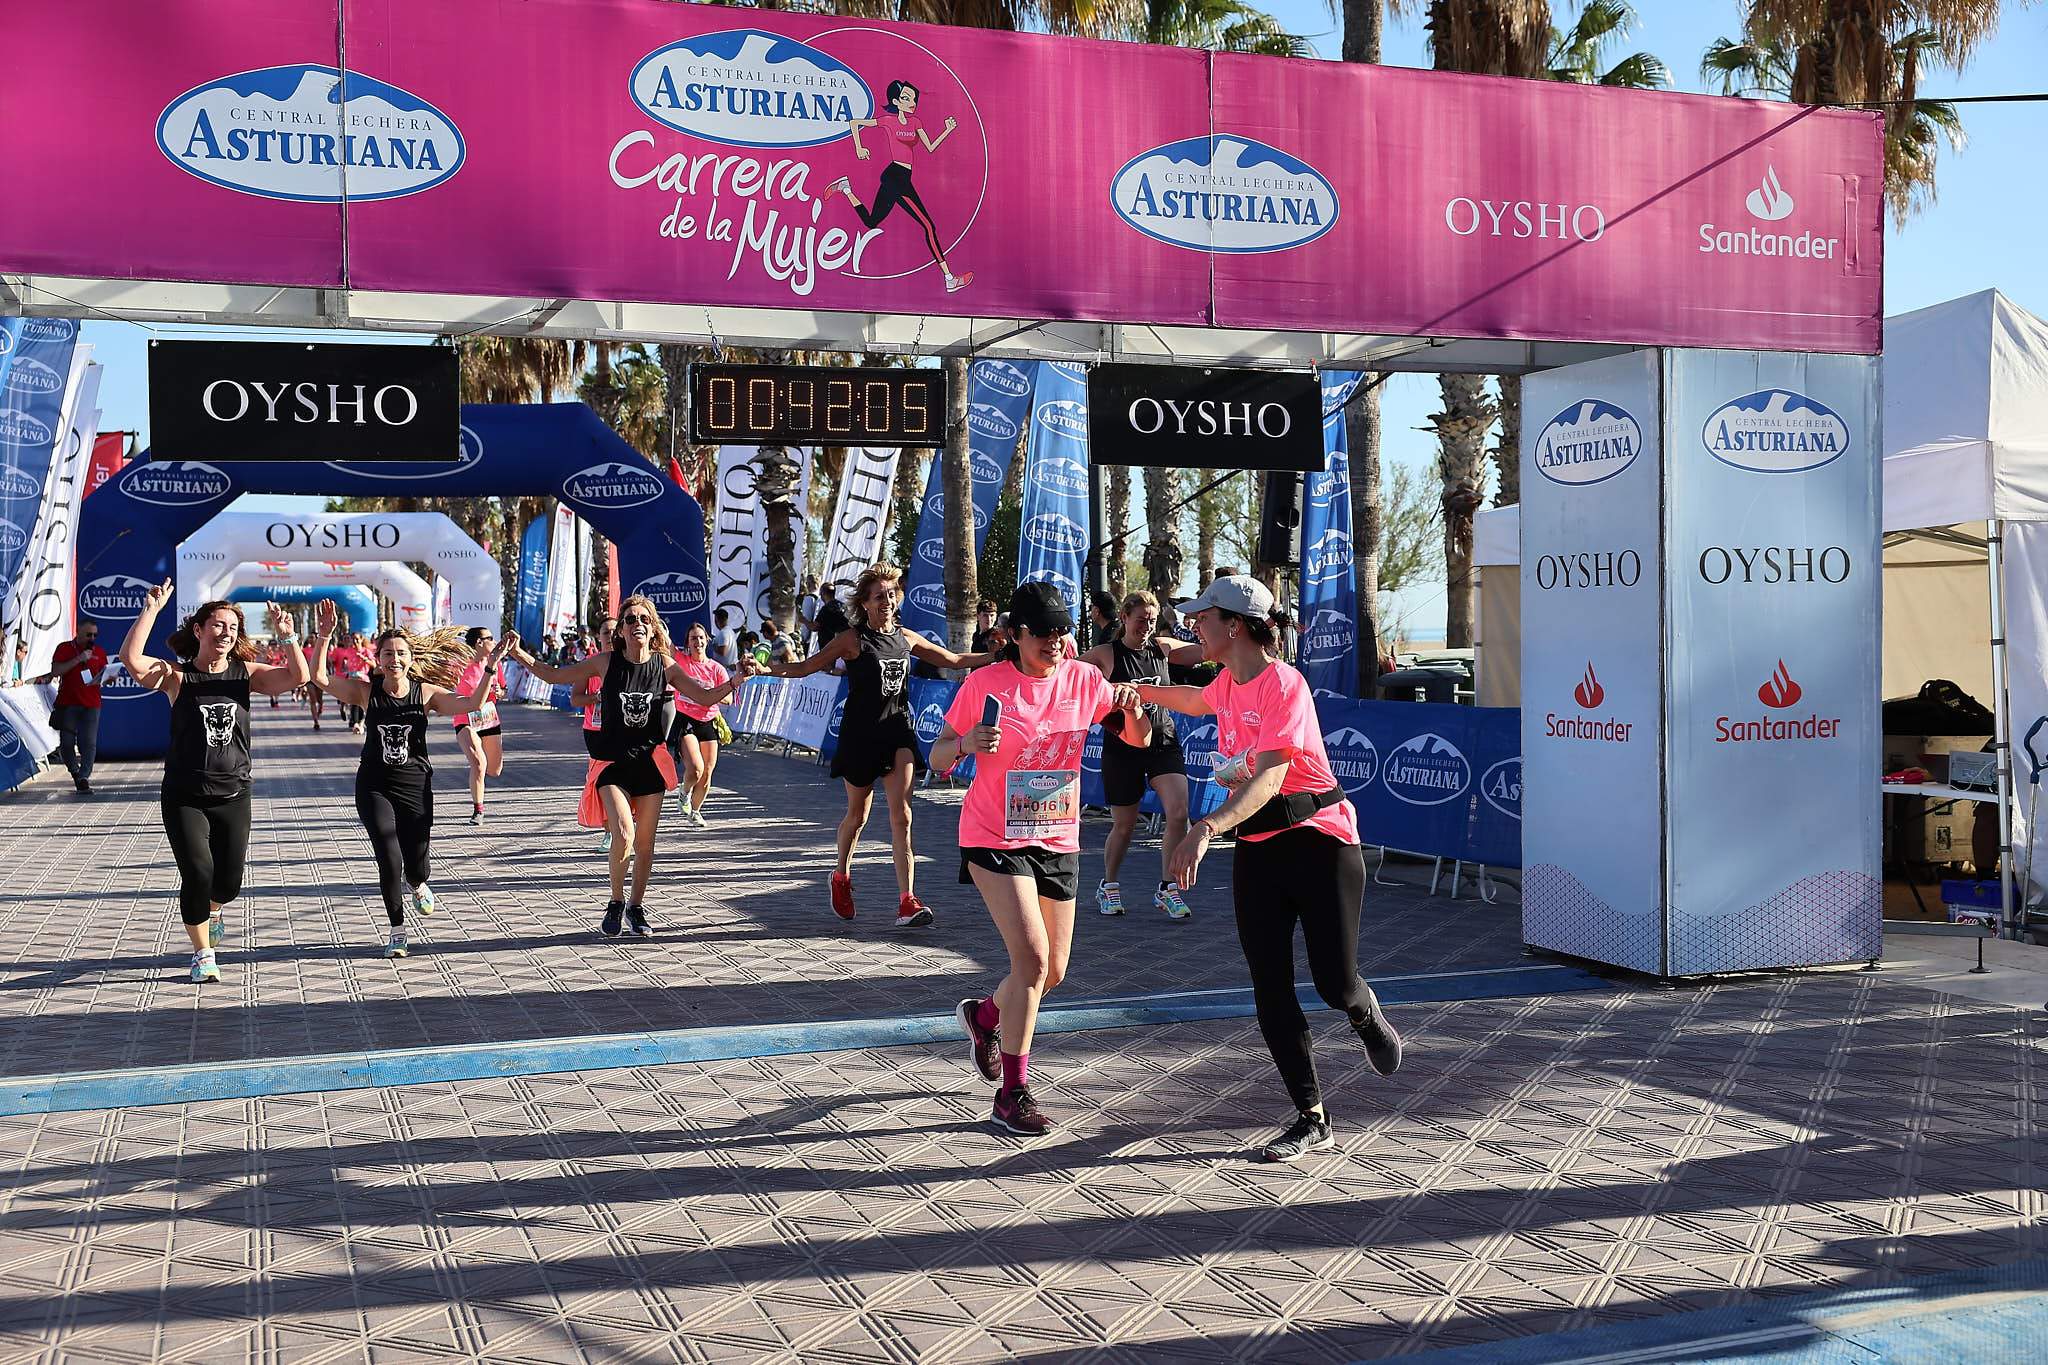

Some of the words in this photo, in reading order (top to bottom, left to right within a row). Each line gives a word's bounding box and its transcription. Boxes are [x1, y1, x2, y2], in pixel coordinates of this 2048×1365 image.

[687, 65, 764, 82] CENTRAL
[772, 72, 847, 89] LECHERA
[649, 65, 854, 122] ASTURIANA
[230, 107, 326, 126] CENTRAL
[181, 108, 442, 171] ASTURIANA
[608, 130, 811, 201] Carrera
[1165, 172, 1236, 187] CENTRAL
[1243, 177, 1314, 192] LECHERA
[1129, 172, 1322, 226] ASTURIANA
[1444, 196, 1605, 243] OYSHO
[659, 197, 697, 238] de
[706, 198, 733, 242] la
[727, 198, 884, 296] Mujer
[1698, 223, 1838, 260] Santander
[24, 323, 68, 338] TURIANA
[8, 371, 55, 389] TURIANA
[203, 379, 419, 426] OYSHO
[968, 414, 1011, 436] STURIANA
[1041, 407, 1088, 433] ASTURIA
[1128, 397, 1291, 438] OYSHO
[1735, 418, 1782, 427] CENTRAL
[1786, 419, 1833, 428] LECHERA
[1712, 419, 1839, 452] ASTURIANA
[1541, 435, 1633, 468] ASTURIANA
[127, 474, 222, 494] ASTURIANA
[572, 480, 658, 497] ASTURIANA
[266, 522, 400, 549] OYSHO
[183, 552, 225, 561] OYSHO
[438, 550, 477, 559] OYSHO
[1699, 546, 1851, 585] OYSHO
[1536, 549, 1641, 590] OYSHO
[83, 591, 146, 609] ASTURIA
[459, 602, 496, 611] OYSHO
[1545, 714, 1632, 742] Santander
[1715, 714, 1841, 742] Santander
[1328, 760, 1371, 779] TURIANA
[1387, 756, 1460, 790] ASTURIANA
